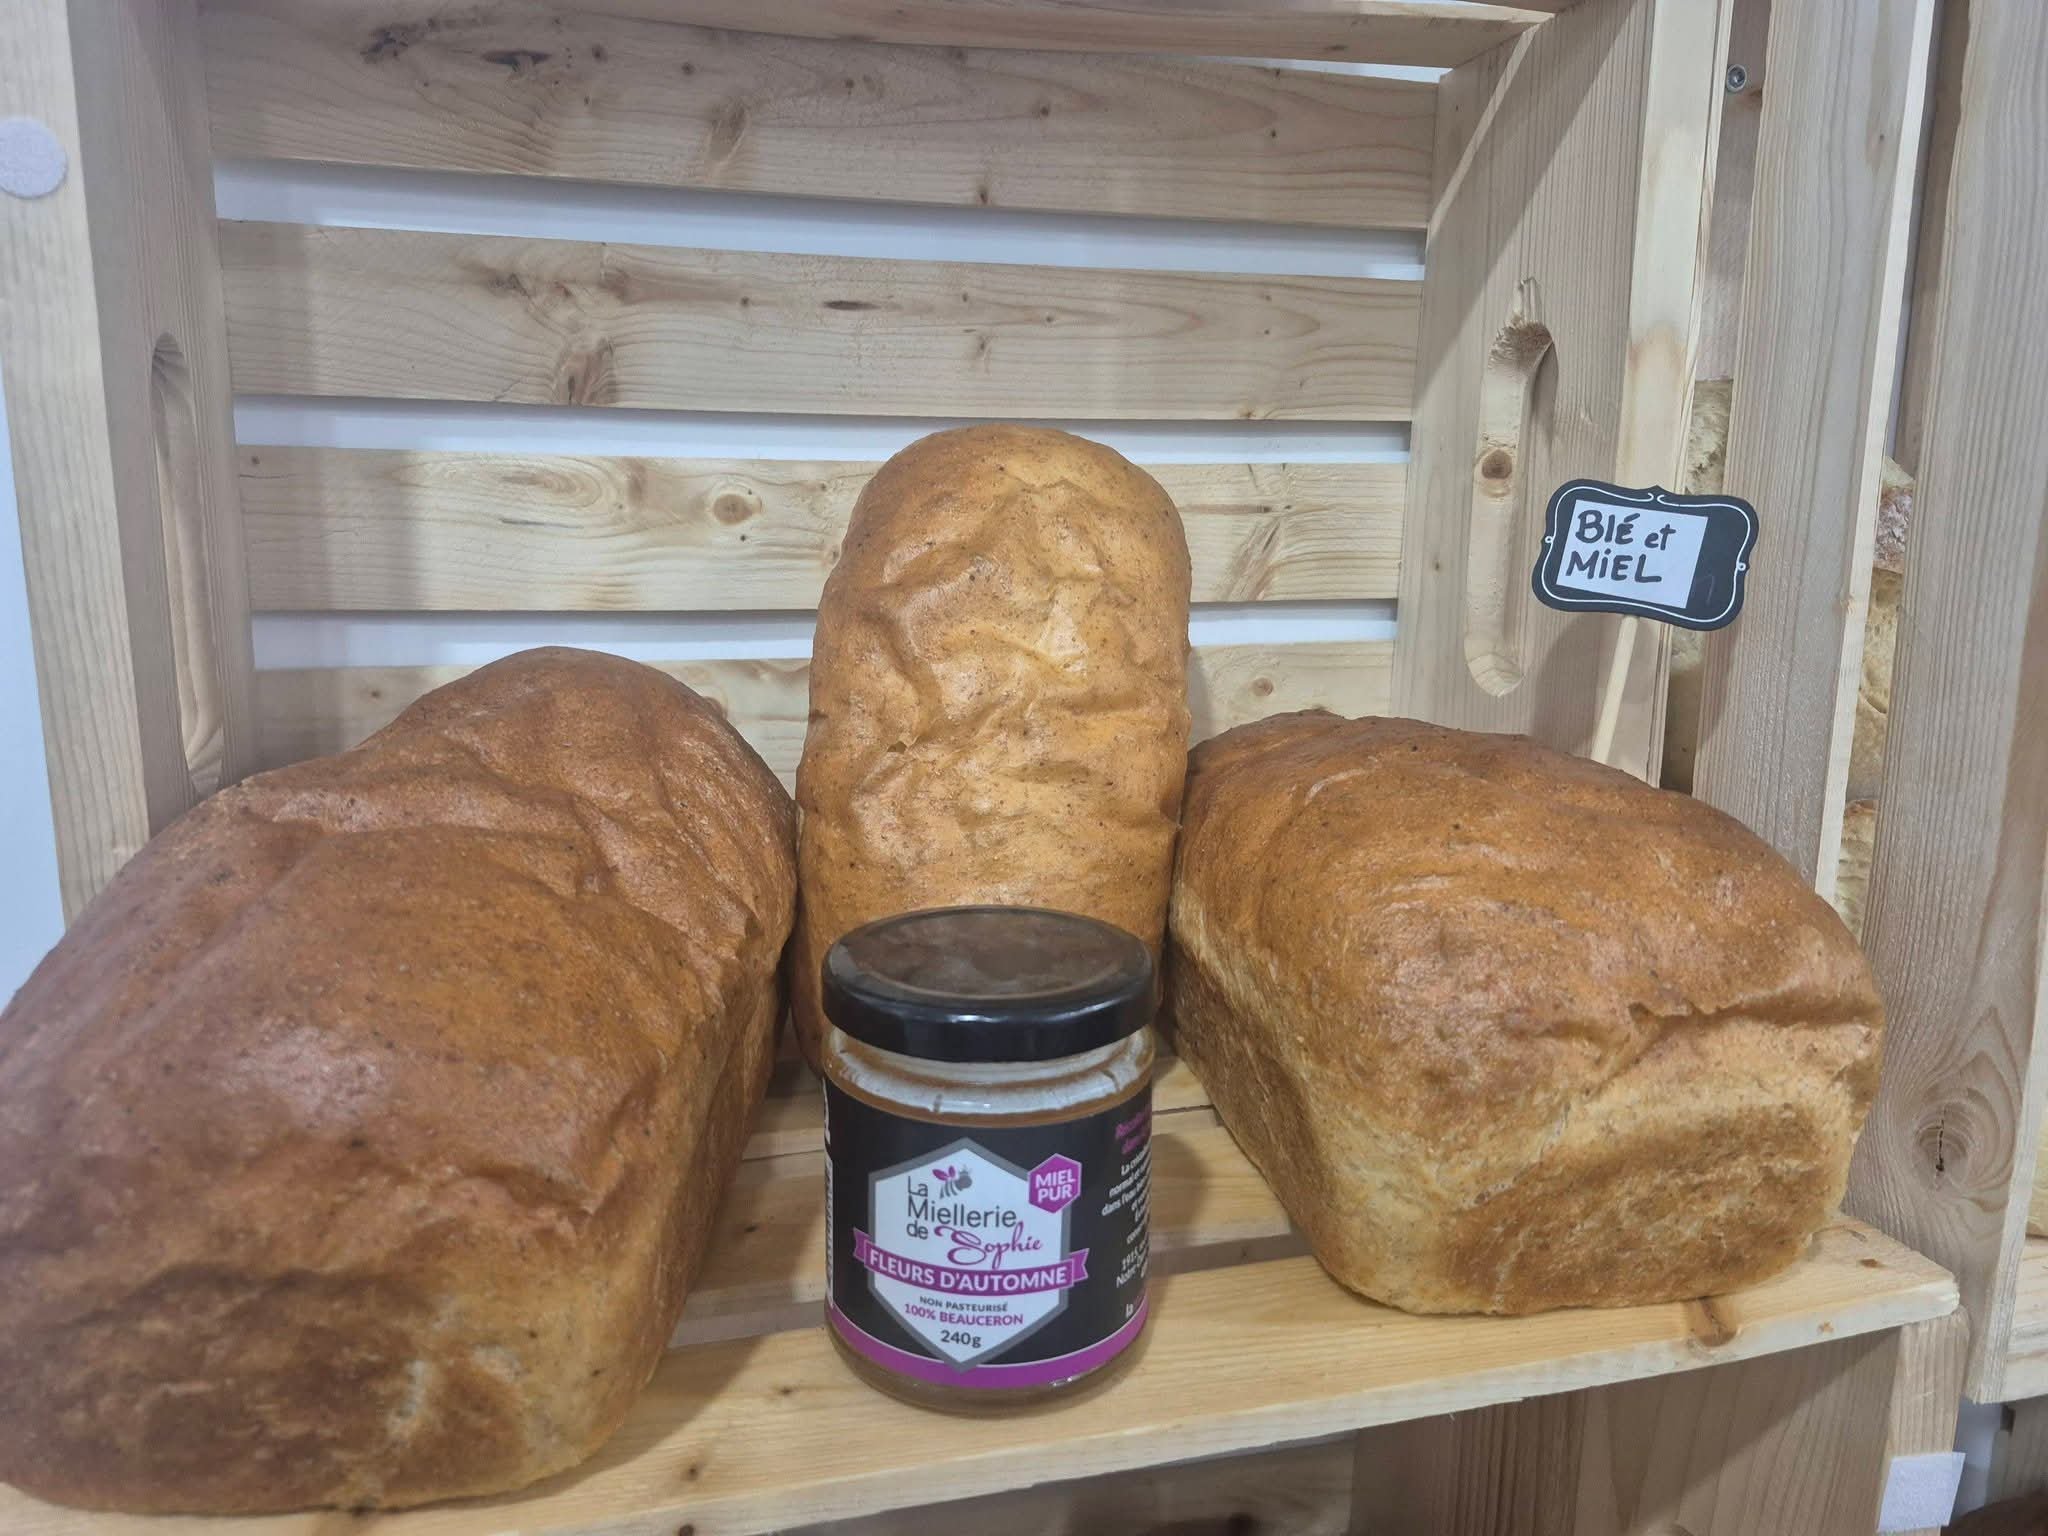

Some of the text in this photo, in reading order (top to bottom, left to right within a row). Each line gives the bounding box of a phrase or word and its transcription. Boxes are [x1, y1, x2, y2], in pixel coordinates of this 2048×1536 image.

[1644, 523, 1676, 550] et
[906, 1175, 929, 1197] La
[1034, 1169, 1075, 1191] MIEL
[1037, 1185, 1073, 1204] PUR
[906, 1195, 1017, 1229] Miellerie
[905, 1220, 1044, 1271] de Sophie
[868, 1252, 1068, 1290] FLEURS D'AUTOMNE
[904, 1303, 1024, 1327] 100% BEAUCERON
[919, 1295, 1008, 1313] NON PASTEURISÉ
[939, 1329, 982, 1349] 240g
